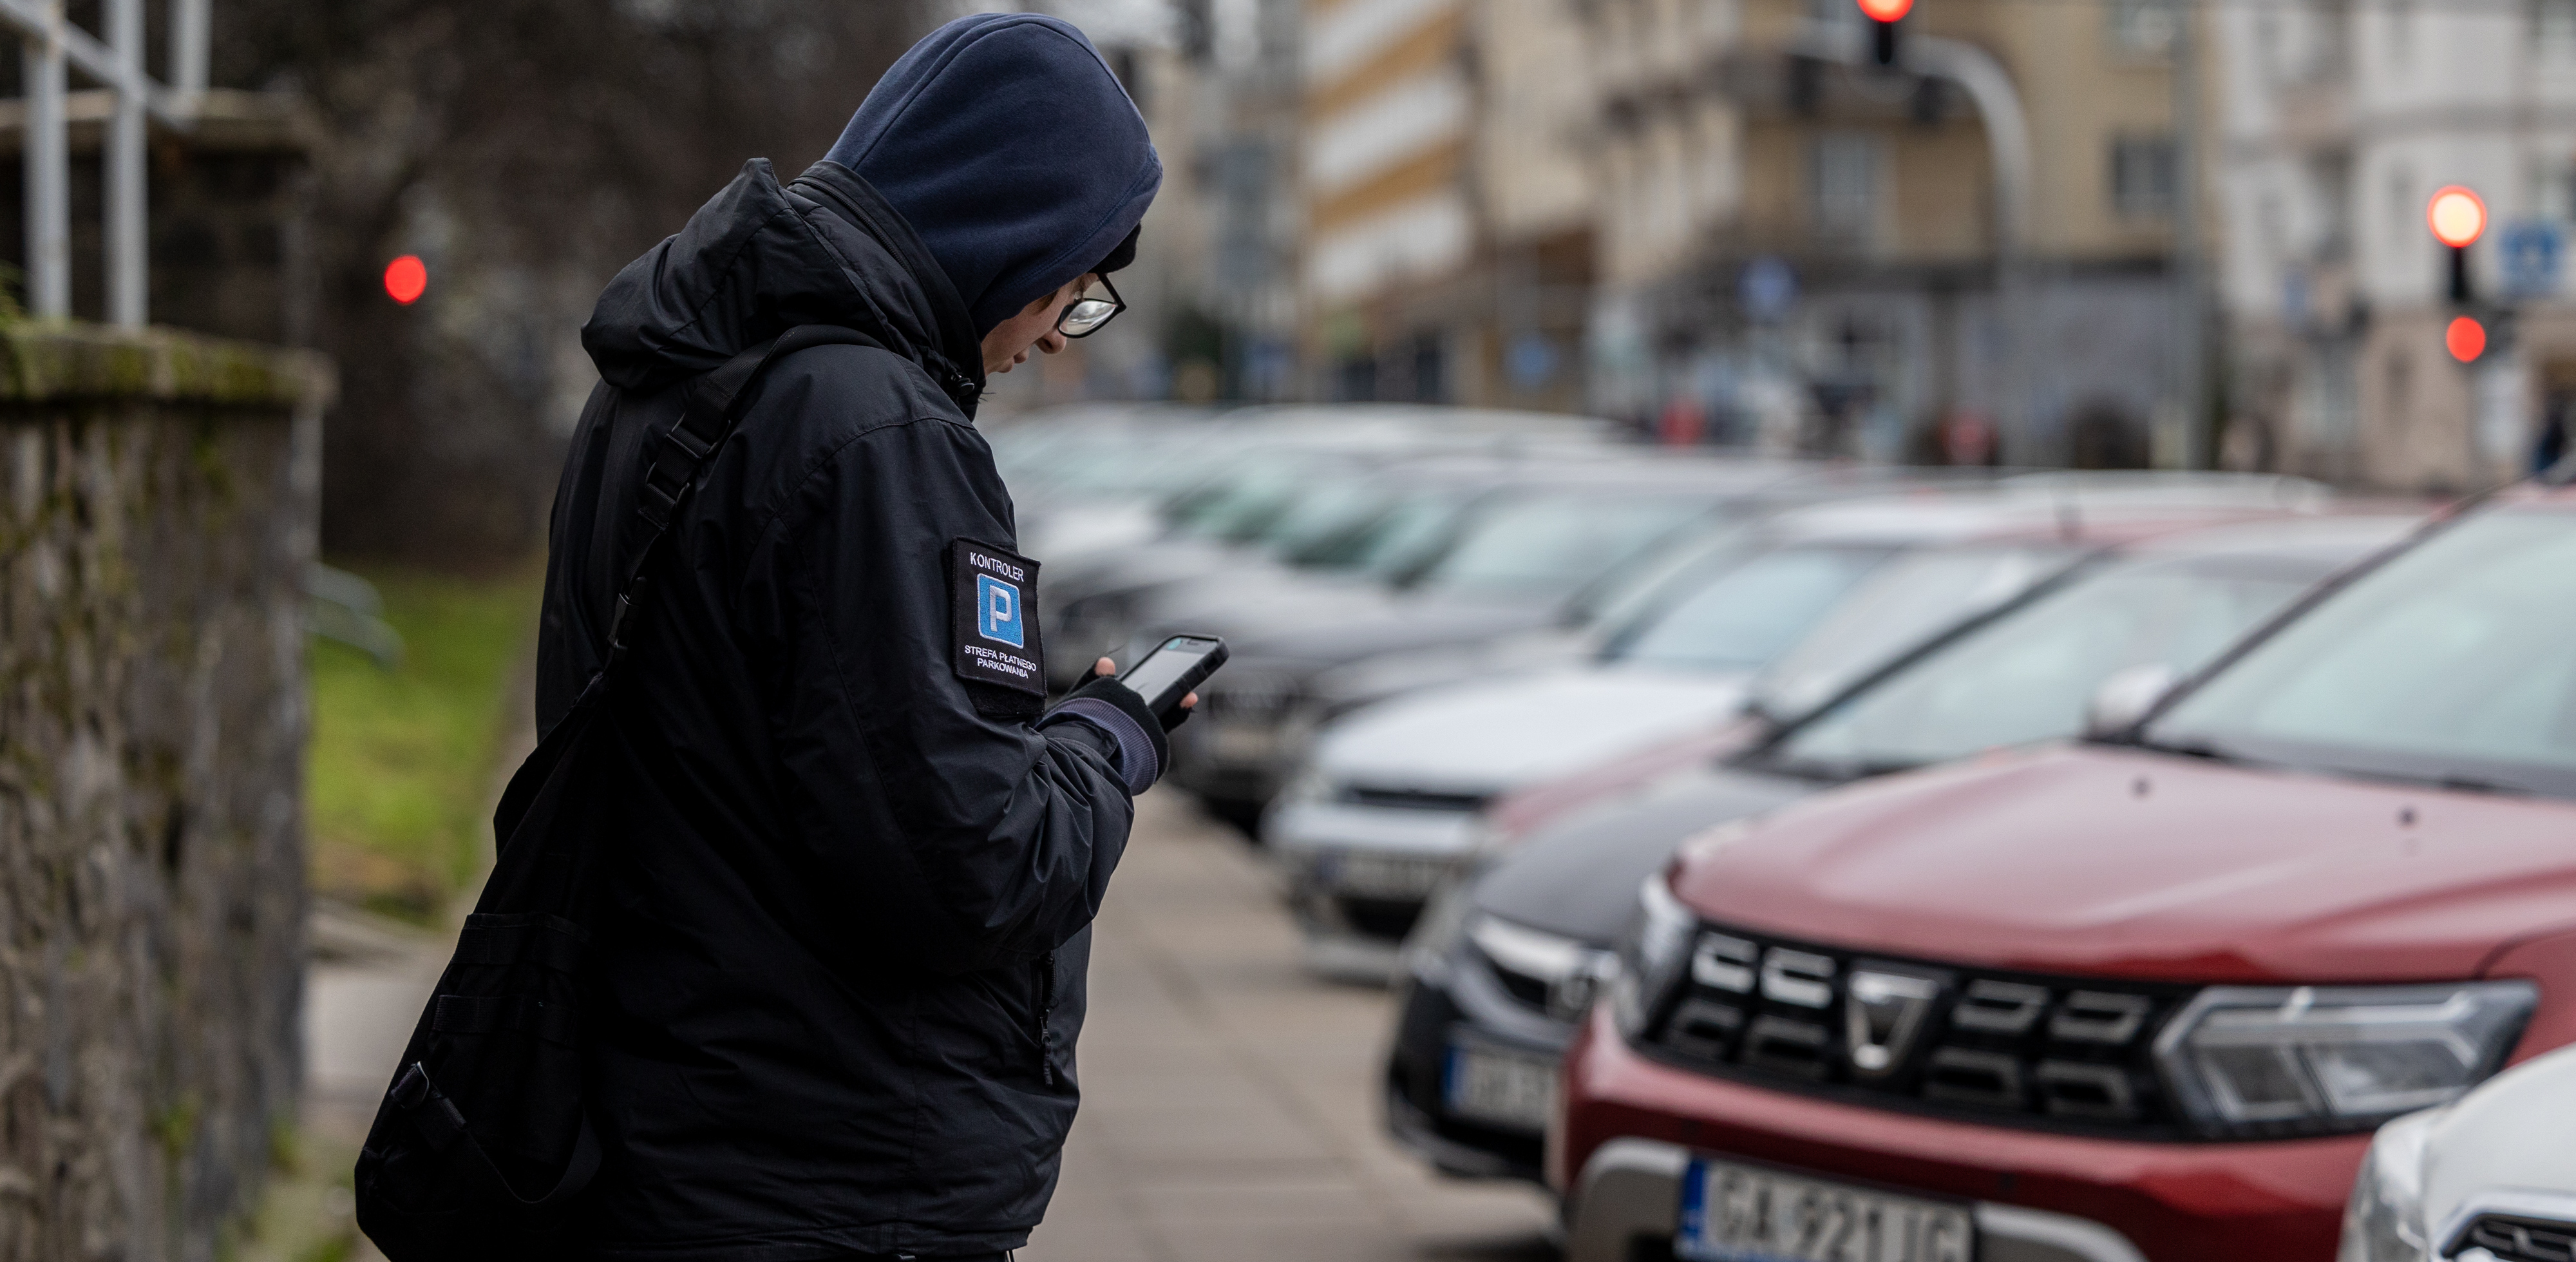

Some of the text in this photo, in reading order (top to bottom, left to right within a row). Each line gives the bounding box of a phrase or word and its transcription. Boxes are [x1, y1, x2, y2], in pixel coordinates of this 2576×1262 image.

[970, 552, 1024, 582] KONTROLER
[989, 585, 1012, 633] P
[965, 645, 1037, 671] STREFA PŁATNEGO
[978, 658, 1028, 678] PARKOWANIA
